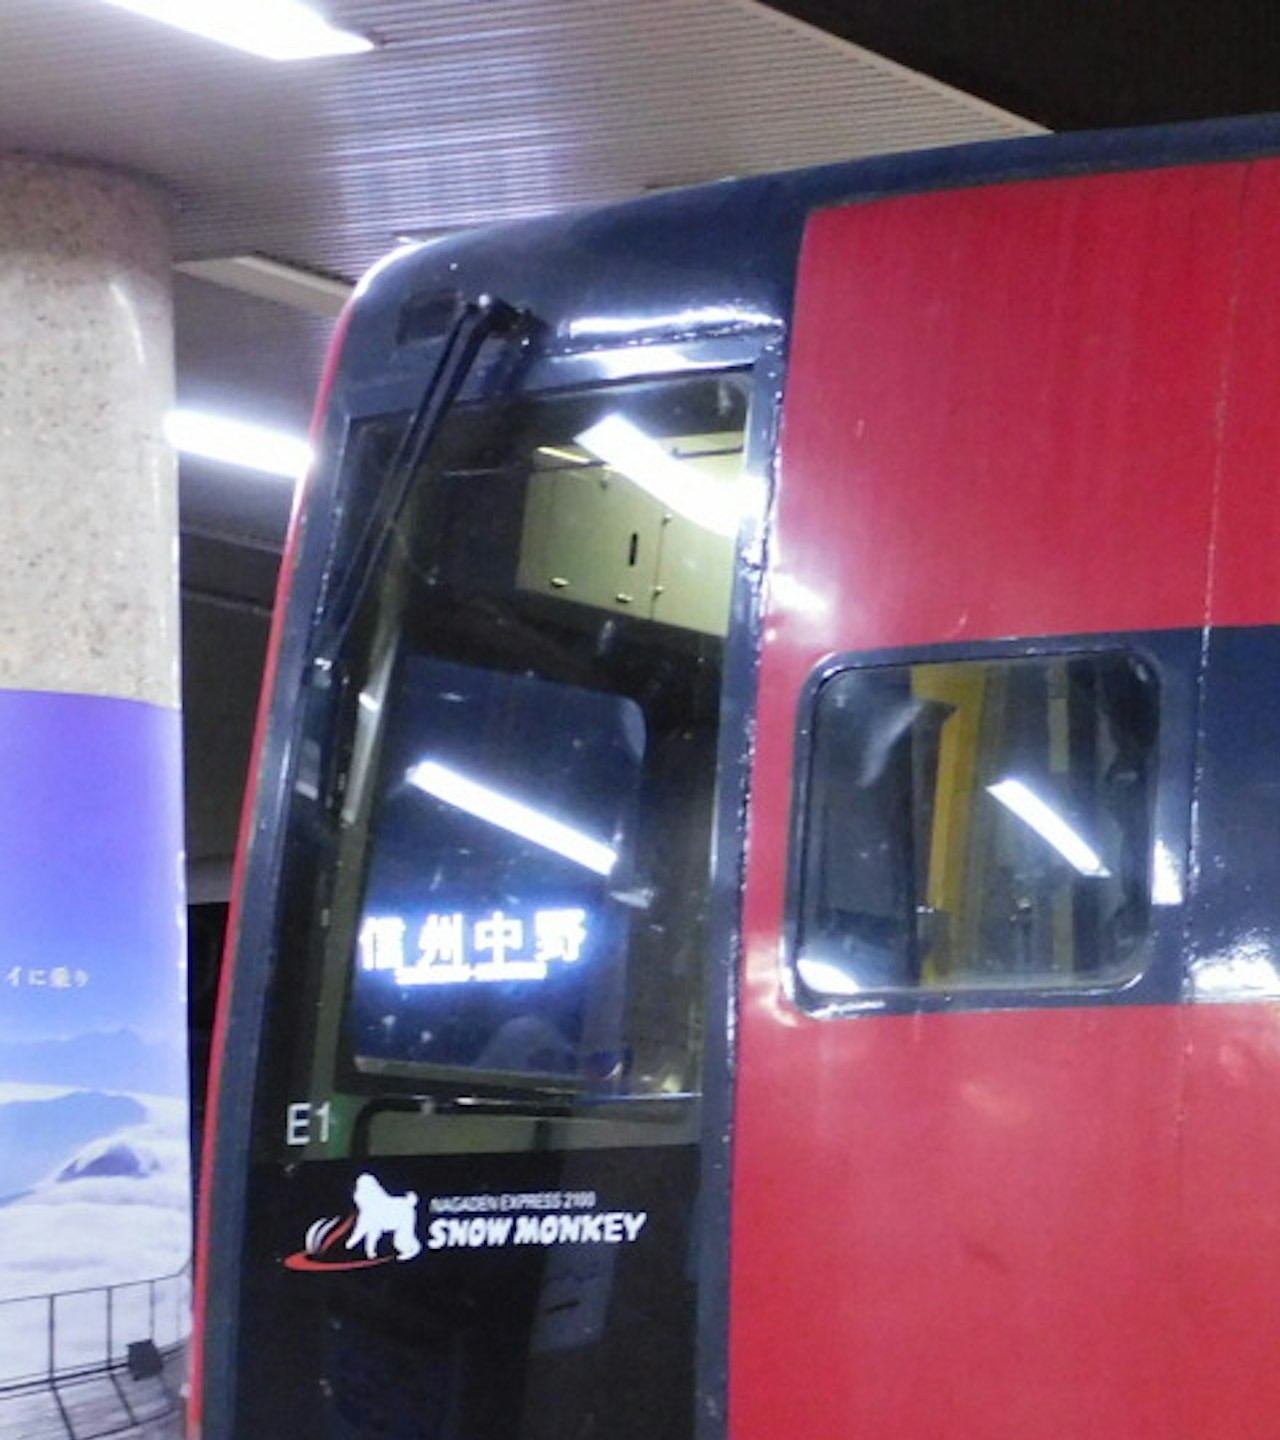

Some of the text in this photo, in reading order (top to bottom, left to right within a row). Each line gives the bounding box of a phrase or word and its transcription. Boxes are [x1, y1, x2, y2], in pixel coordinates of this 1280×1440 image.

[286, 1101, 331, 1146] E1
[500, 1192, 561, 1212] EXPRESS
[428, 1211, 648, 1250] SNOW MONKEY
